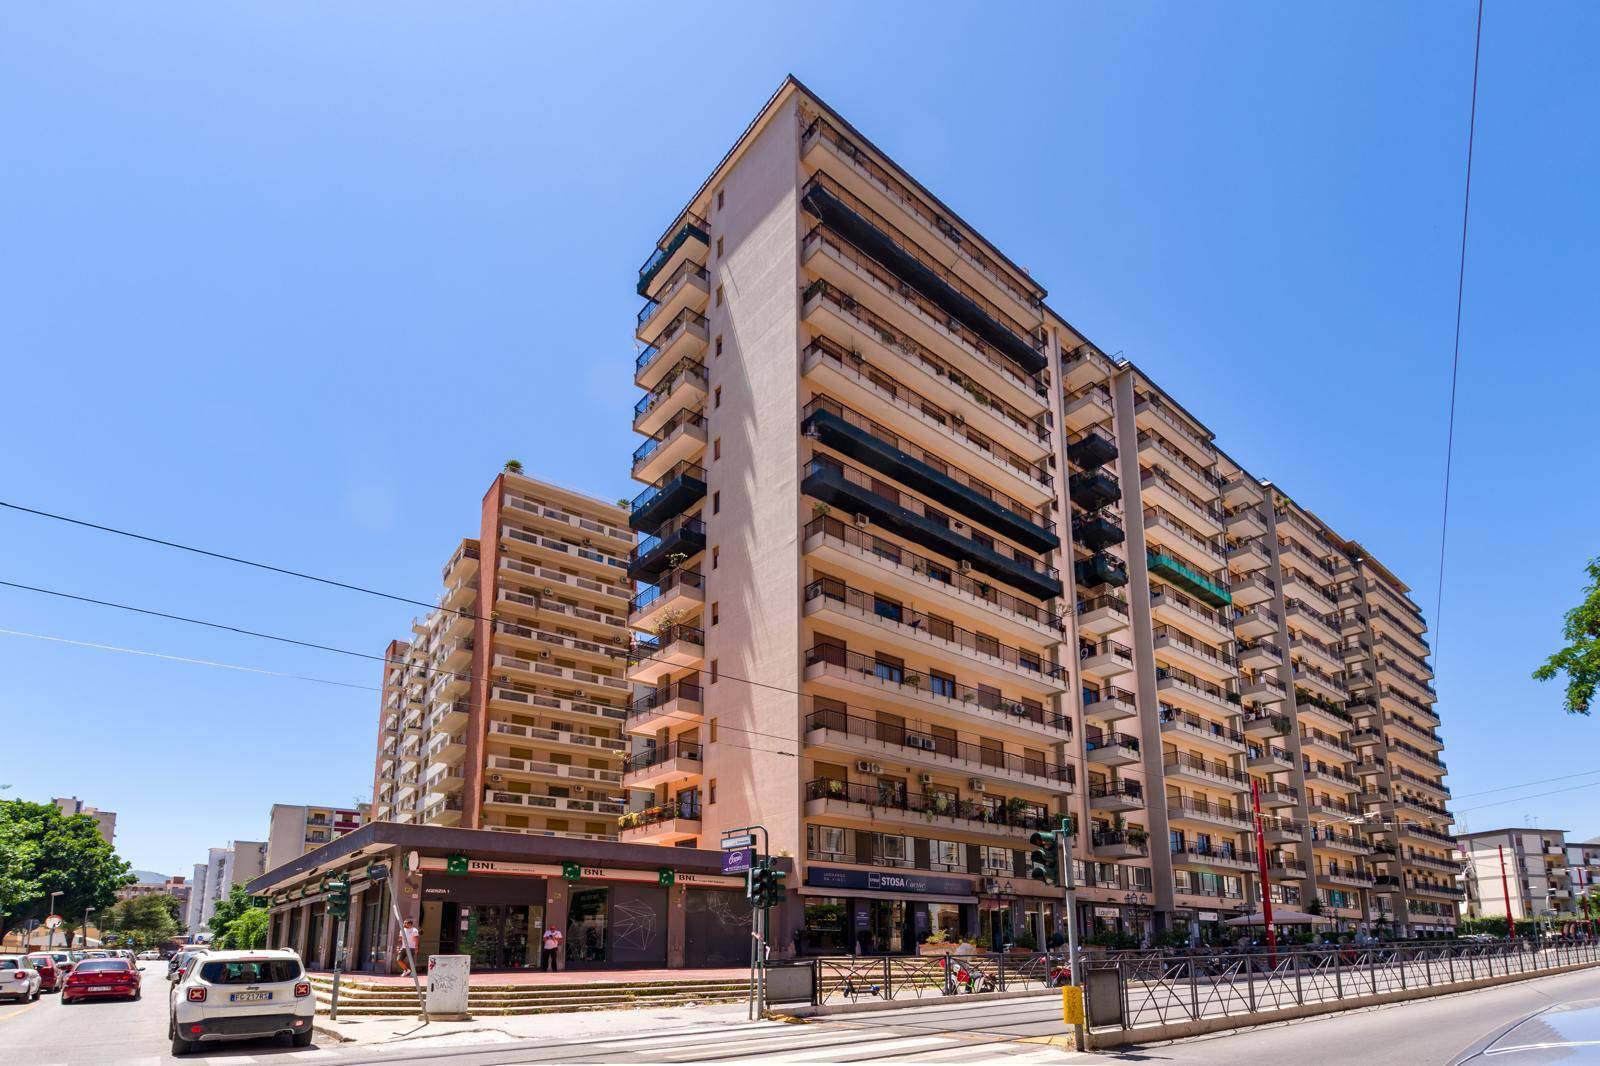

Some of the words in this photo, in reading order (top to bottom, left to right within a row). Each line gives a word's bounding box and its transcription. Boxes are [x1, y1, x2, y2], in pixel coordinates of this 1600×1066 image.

[471, 861, 497, 870] BNL
[583, 868, 606, 877] BNL
[678, 874, 698, 882] BNL
[881, 876, 905, 887] STOSA
